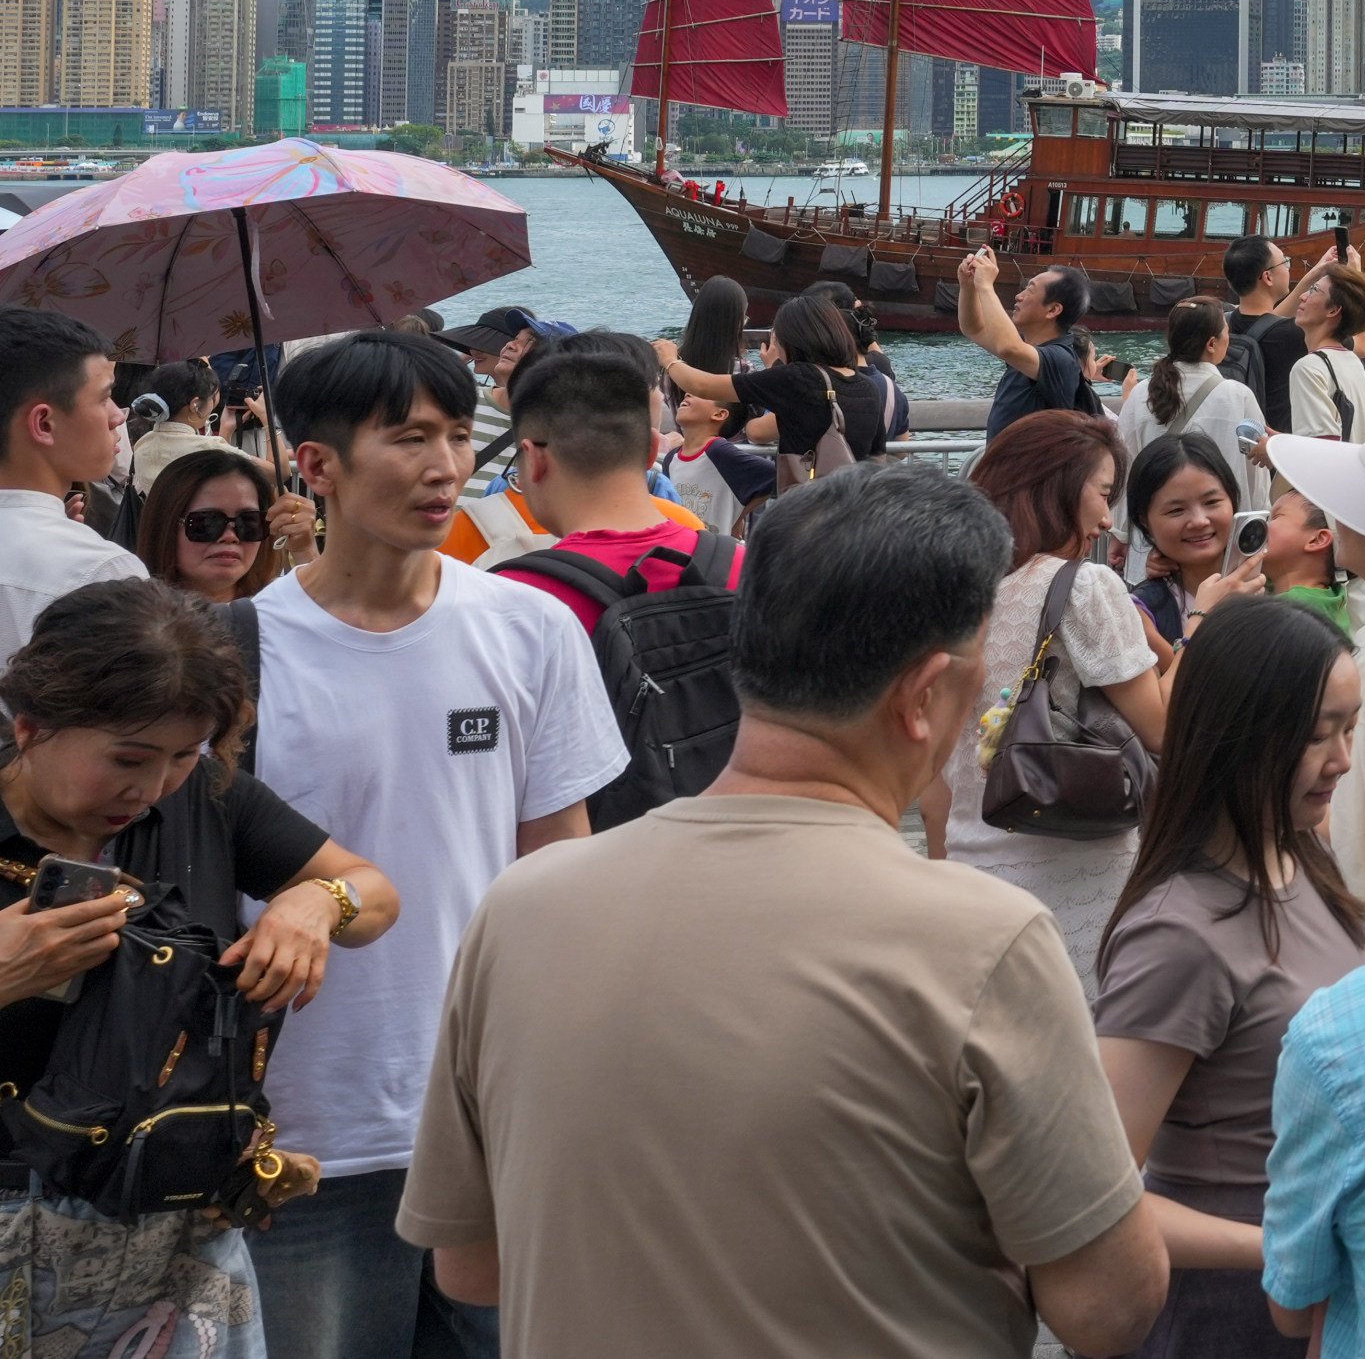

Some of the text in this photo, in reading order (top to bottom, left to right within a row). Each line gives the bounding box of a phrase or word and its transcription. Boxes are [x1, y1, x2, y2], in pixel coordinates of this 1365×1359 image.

[789, 7, 831, 21] カード
[665, 206, 725, 230] AQUALUNA
[456, 733, 492, 744] COMPANY
